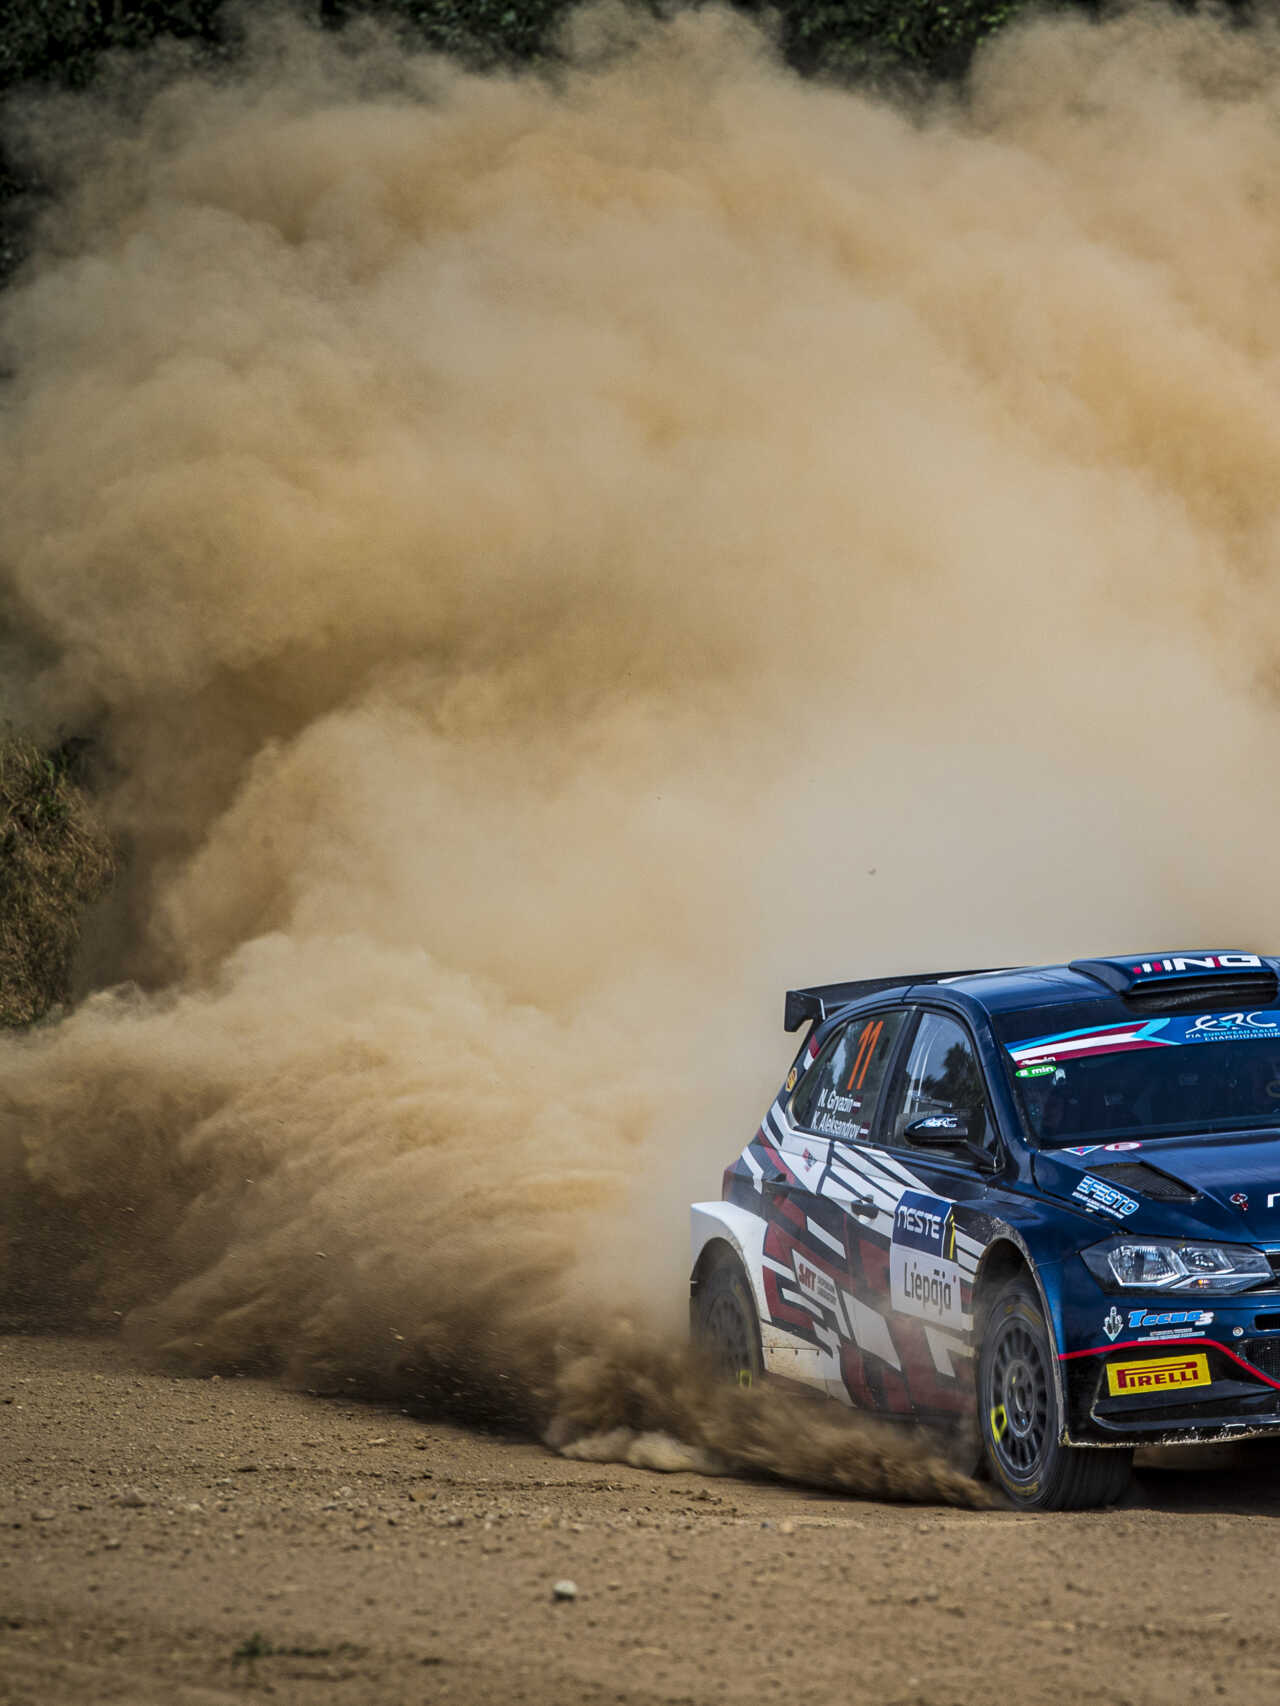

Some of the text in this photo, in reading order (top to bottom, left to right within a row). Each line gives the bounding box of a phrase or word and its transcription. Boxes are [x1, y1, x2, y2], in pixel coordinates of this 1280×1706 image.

[846, 1020, 884, 1091] 11
[817, 1087, 829, 1107] N.
[810, 1110, 821, 1130] K.
[1076, 1175, 1140, 1216] EFESTO
[903, 1261, 952, 1316] Liepāja
[1116, 1361, 1199, 1389] PIRELLI
